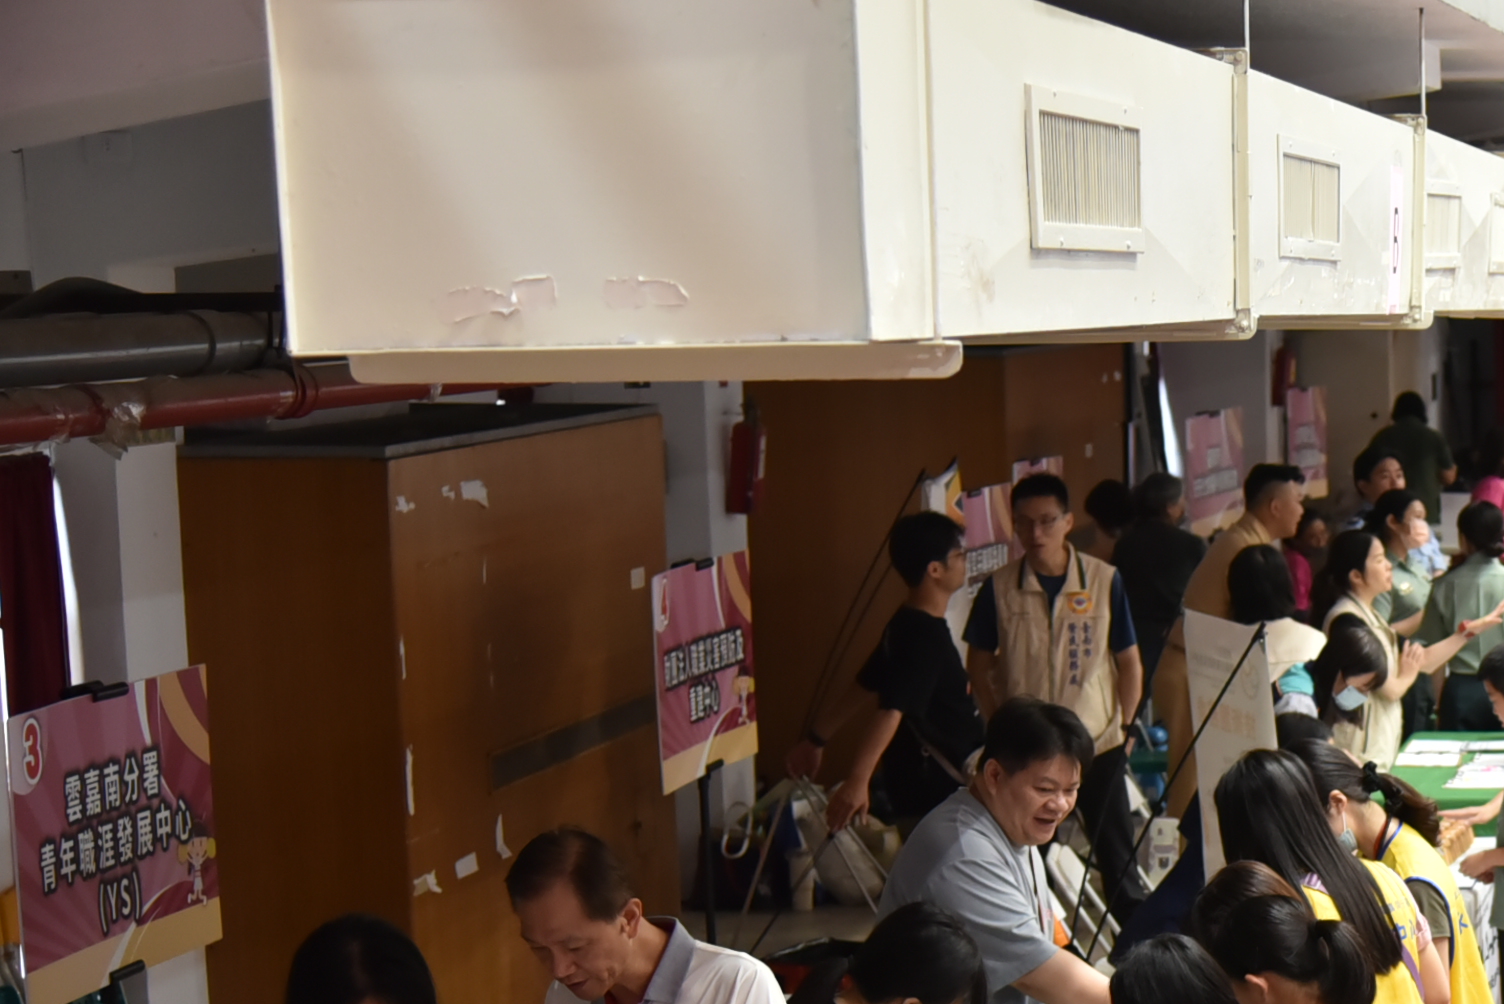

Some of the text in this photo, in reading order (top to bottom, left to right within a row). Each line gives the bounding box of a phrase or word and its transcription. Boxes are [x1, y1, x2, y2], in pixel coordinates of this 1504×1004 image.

[23, 717, 43, 786] 3
[64, 750, 160, 824] 雲嘉南分署
[40, 799, 192, 893] 青年職涯發展中心
[99, 870, 141, 935] (YS)
